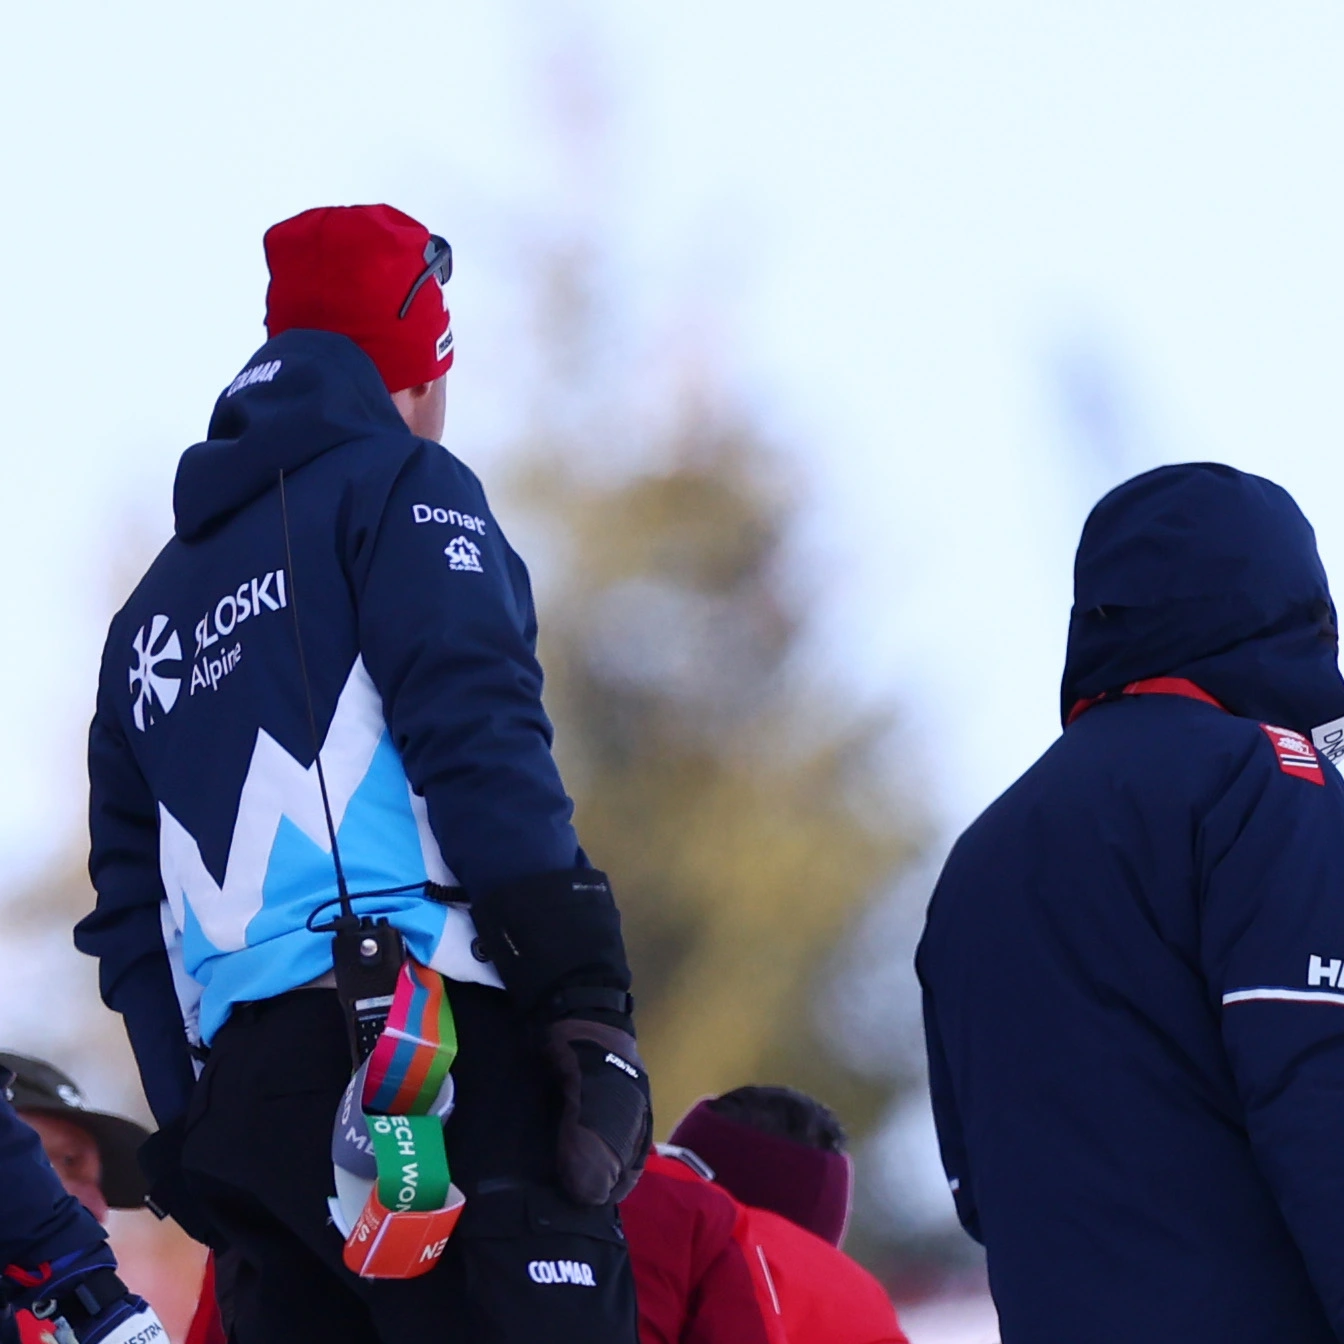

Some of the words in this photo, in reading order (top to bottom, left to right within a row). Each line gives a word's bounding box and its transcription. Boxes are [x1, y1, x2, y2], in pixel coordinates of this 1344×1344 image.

[412, 504, 486, 536] Donat
[194, 569, 287, 659] SLOSKI
[190, 641, 242, 696] Alpine
[528, 1260, 597, 1287] COLMAR
